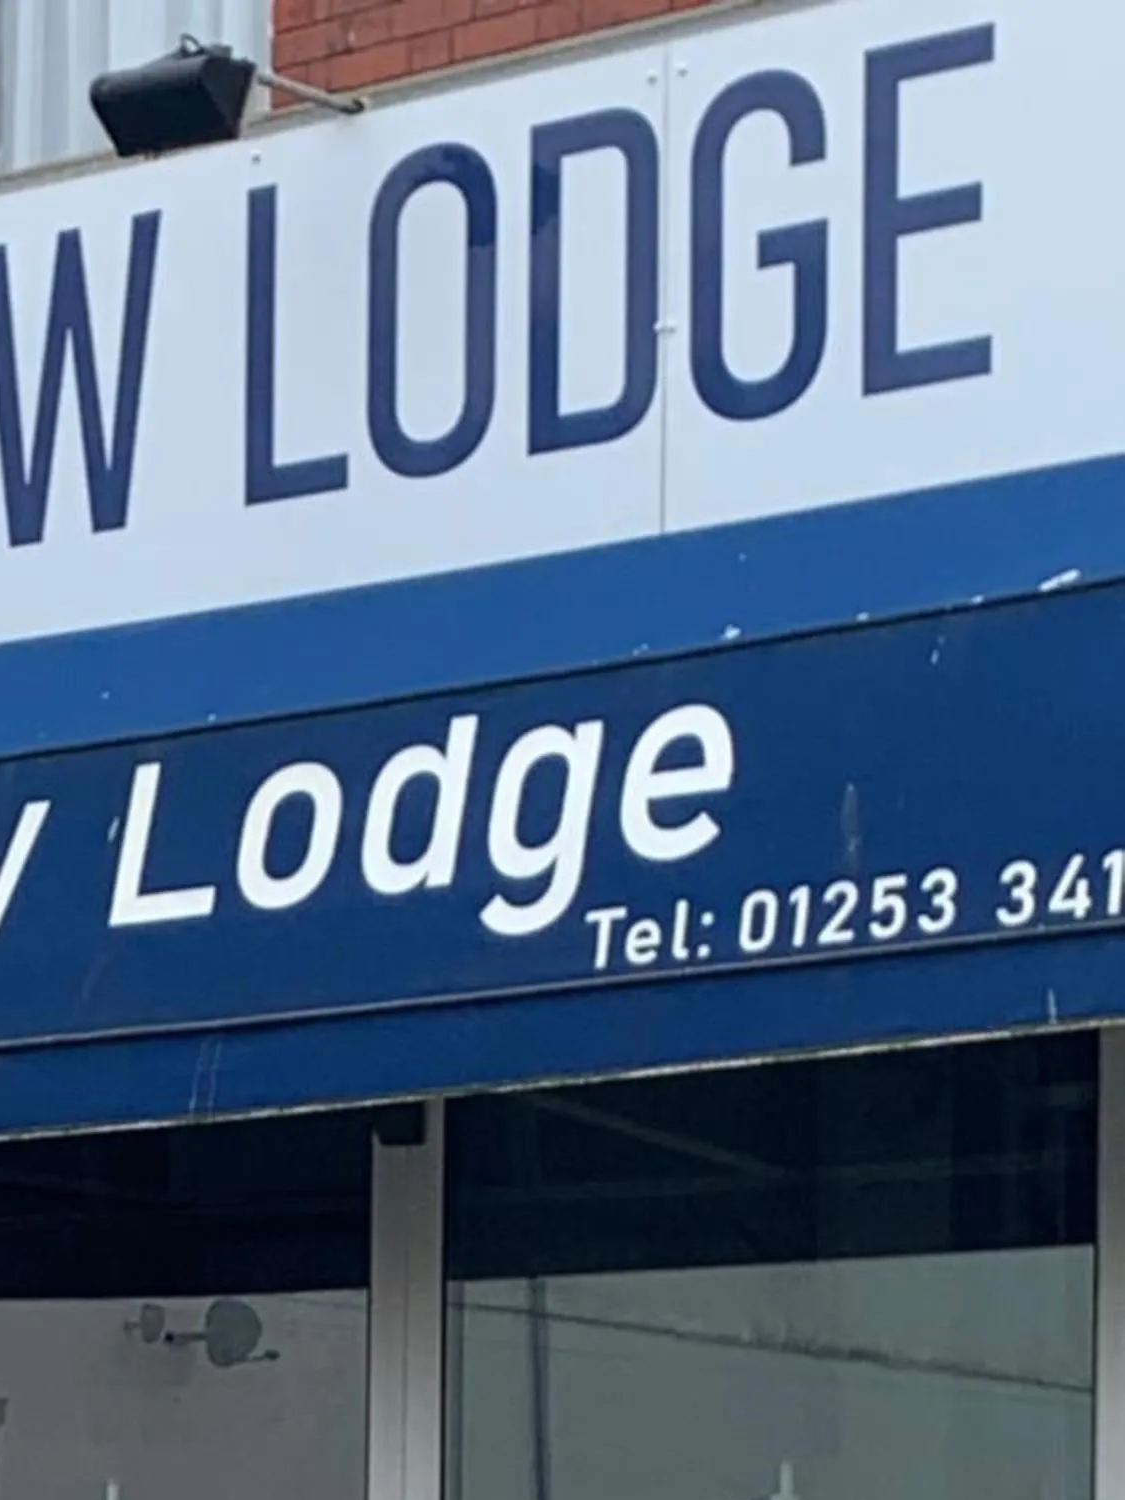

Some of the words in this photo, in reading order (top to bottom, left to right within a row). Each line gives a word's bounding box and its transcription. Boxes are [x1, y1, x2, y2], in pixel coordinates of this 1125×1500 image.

[245, 22, 995, 506] LODGE
[108, 703, 735, 937] Lodge
[585, 898, 714, 970] Tel:
[738, 867, 958, 953] 01253
[995, 848, 1125, 927] 341
